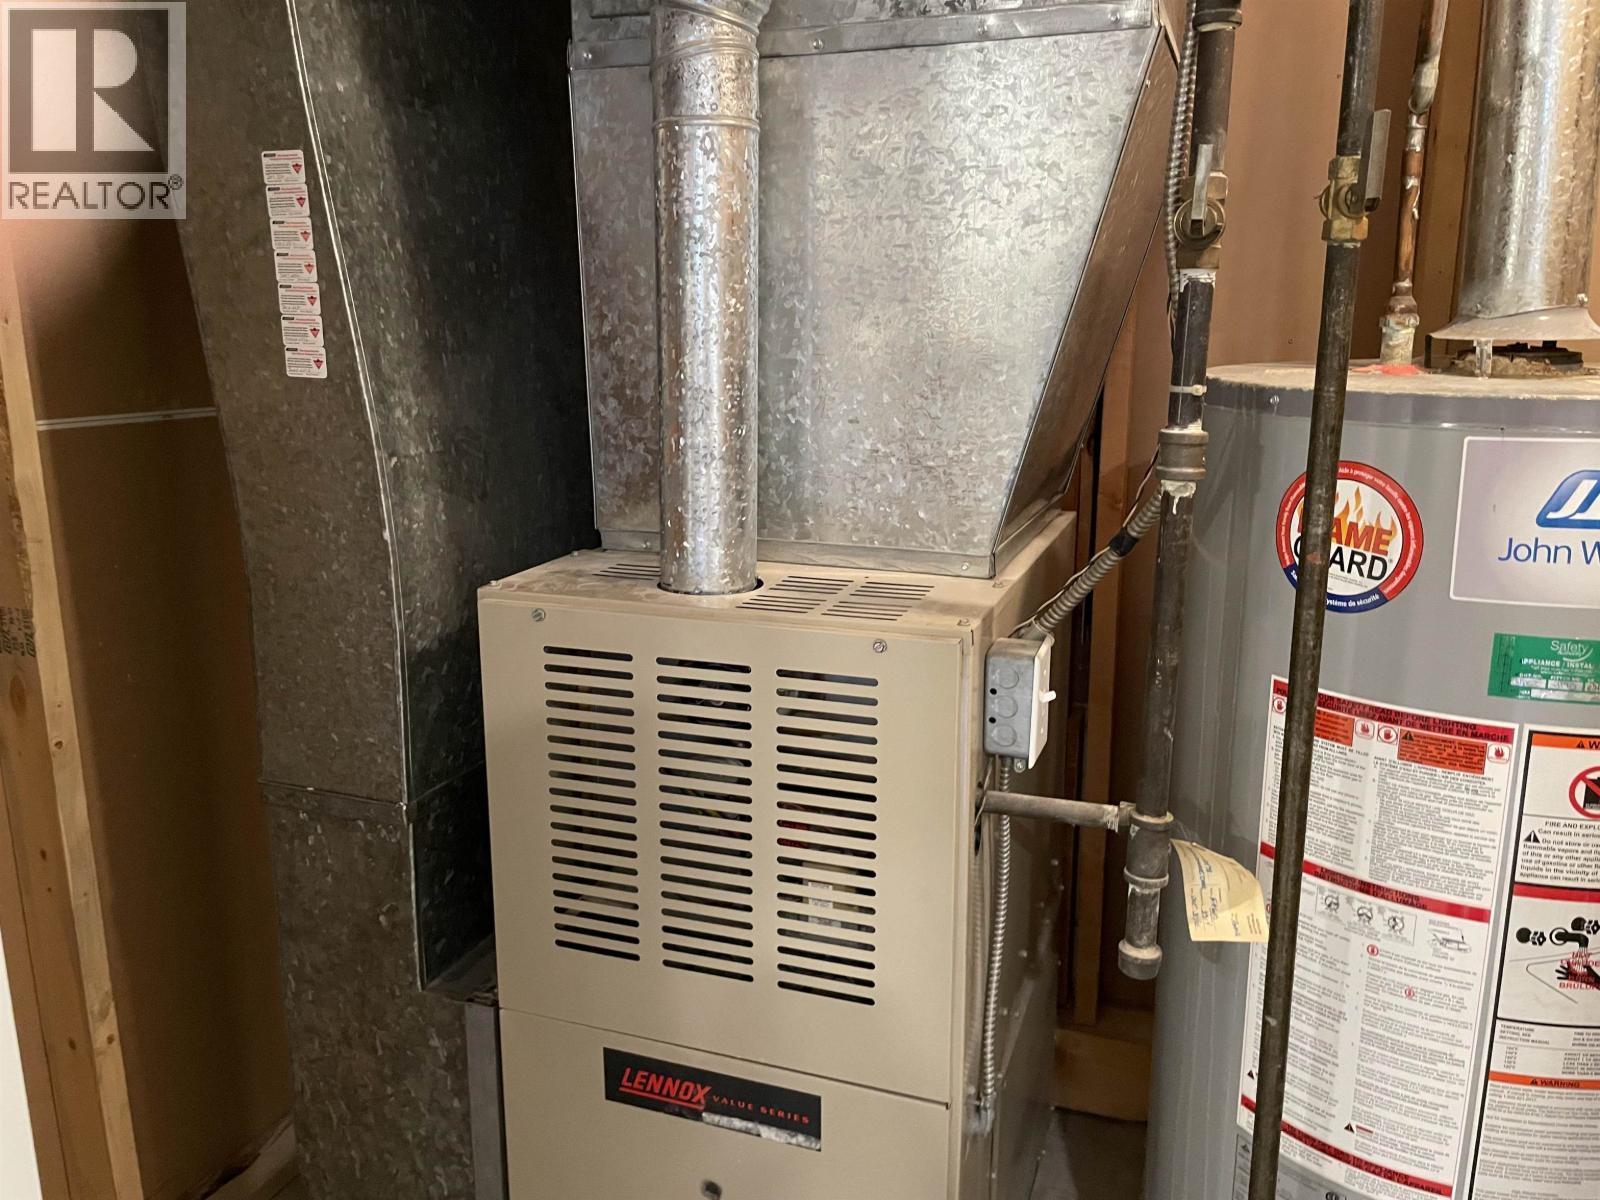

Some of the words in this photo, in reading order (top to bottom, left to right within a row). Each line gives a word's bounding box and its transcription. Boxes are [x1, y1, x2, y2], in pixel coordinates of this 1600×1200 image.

[1498, 537, 1572, 564] John
[1550, 640, 1587, 654] Safety
[1470, 730, 1508, 743] MARCHE
[1540, 1079, 1580, 1088] WARNING
[621, 1067, 712, 1104] LENNOX
[712, 1095, 754, 1112] VALUE
[759, 1105, 810, 1124] SERIES
